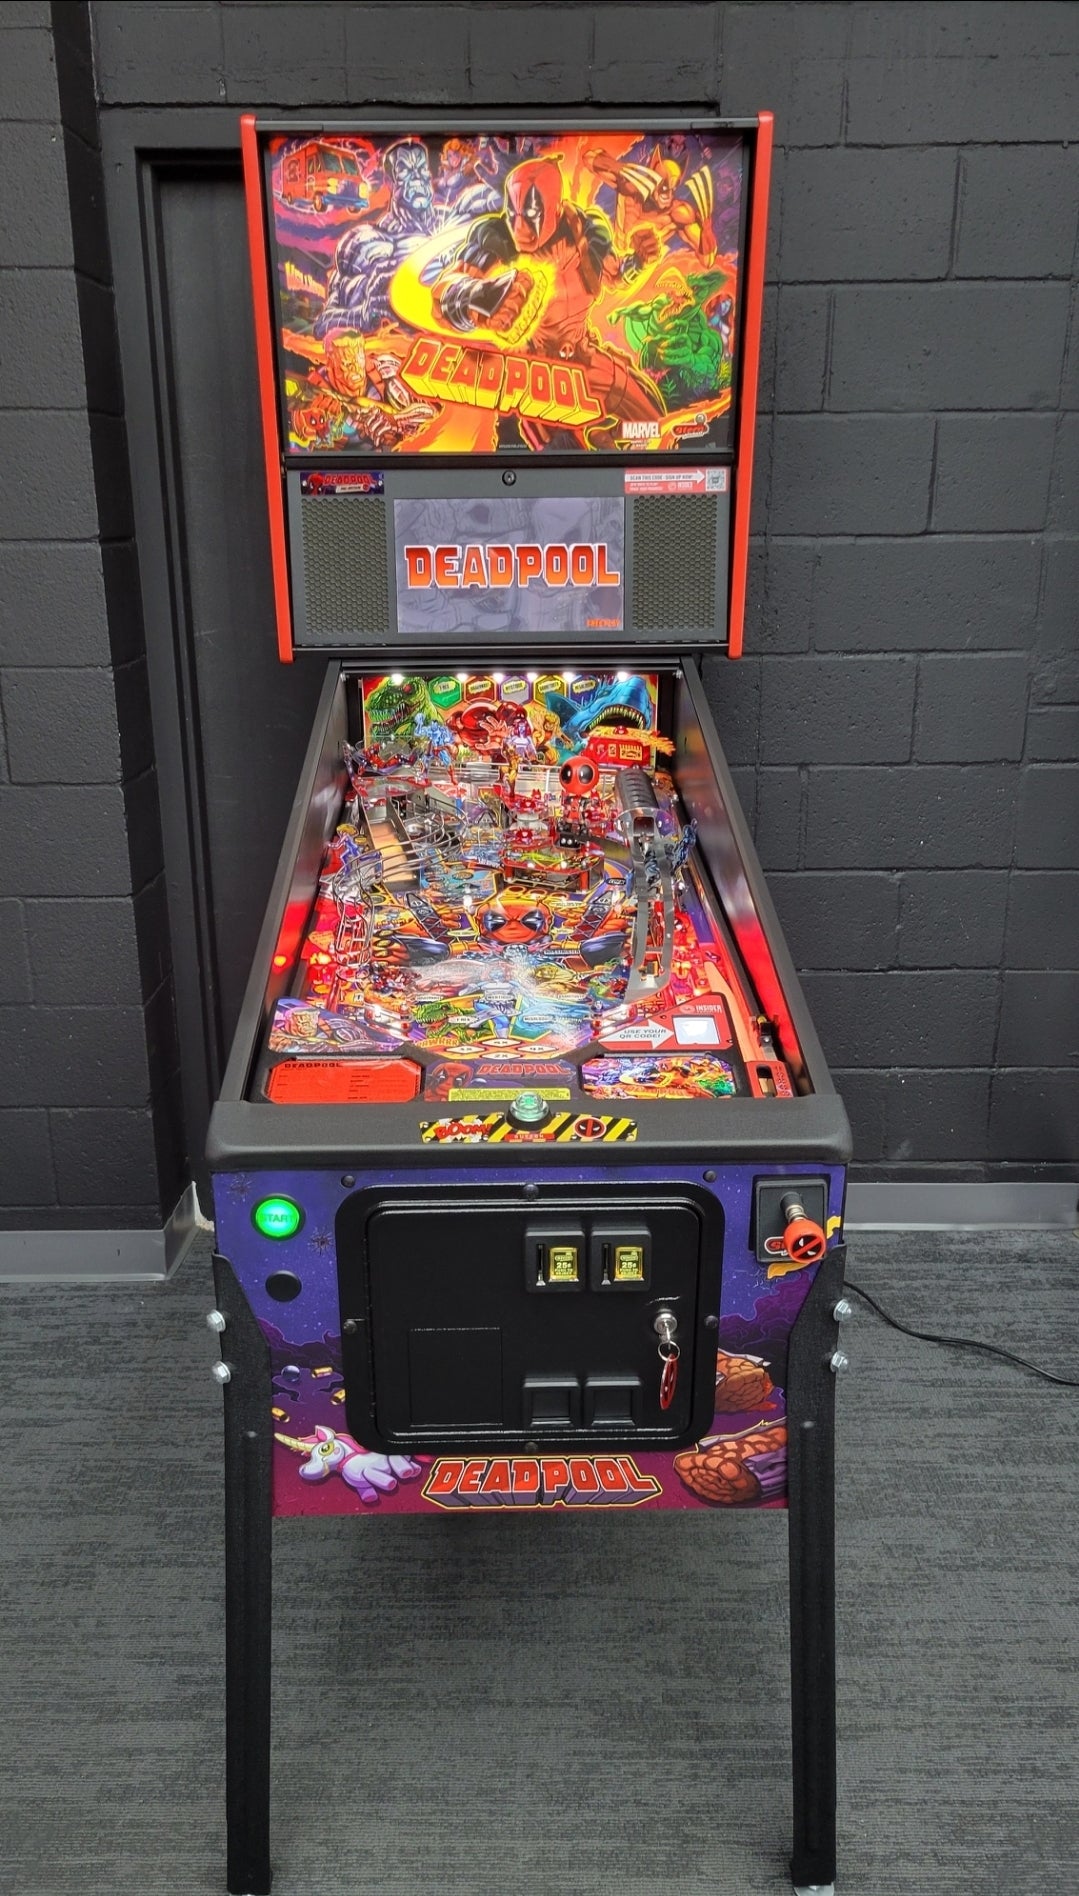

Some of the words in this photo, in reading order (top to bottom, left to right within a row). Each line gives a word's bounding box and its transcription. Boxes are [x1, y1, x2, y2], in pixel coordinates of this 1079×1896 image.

[400, 338, 602, 425] DEADPOOL
[622, 422, 660, 438] MARVEL
[404, 544, 621, 589] DEADPOOL
[477, 1063, 570, 1076] DEADPOOL
[434, 1121, 492, 1139] BOOM!
[262, 1214, 293, 1223] START
[426, 1458, 658, 1504] DEADPOOL
